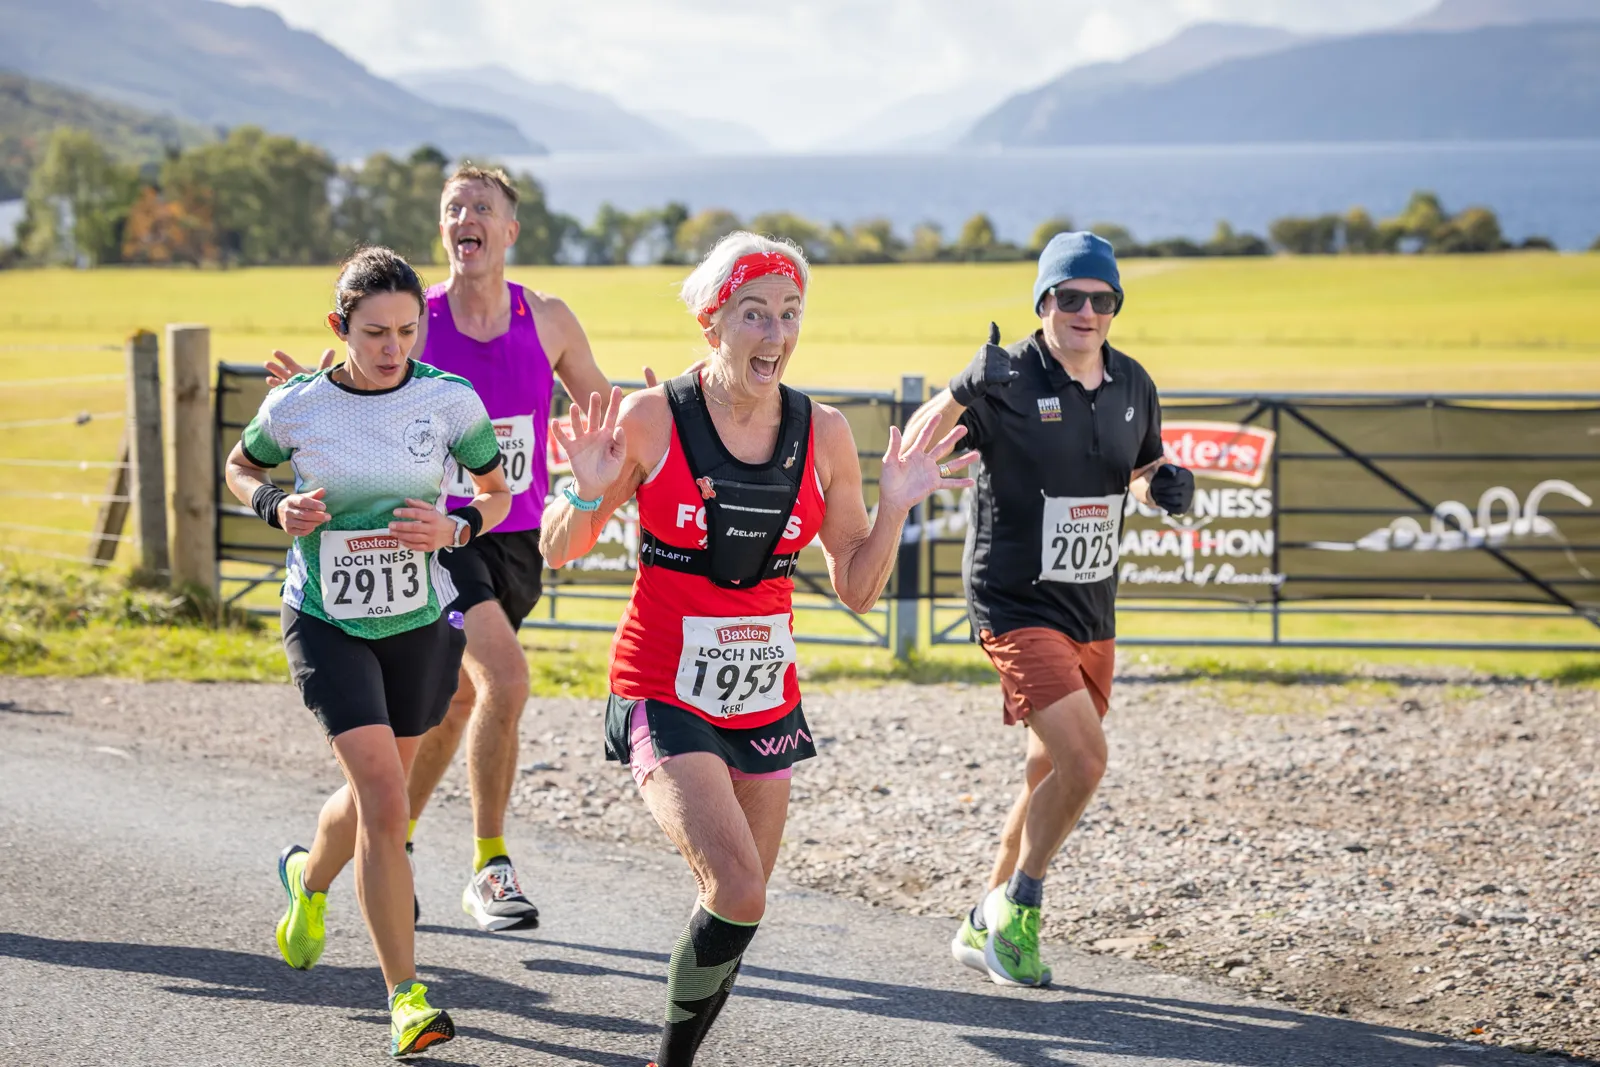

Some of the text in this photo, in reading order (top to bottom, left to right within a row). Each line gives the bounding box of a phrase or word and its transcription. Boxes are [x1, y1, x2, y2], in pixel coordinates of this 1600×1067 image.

[1163, 432, 1258, 472] xters
[1194, 488, 1273, 518] NESS
[1072, 506, 1108, 518] Baxters
[733, 529, 767, 538] ZELAFIT
[1056, 520, 1114, 534] LOCH NESS
[350, 538, 398, 551] Baxters
[1119, 528, 1275, 557] ARATHON
[334, 550, 414, 567] LOCH NESS
[1051, 533, 1113, 570] 2025
[331, 562, 419, 605] 2913
[1075, 572, 1097, 580] PETER
[367, 605, 392, 615] AGA
[720, 628, 769, 642] Baxters
[699, 646, 784, 661] LOCH NESS
[692, 660, 783, 701] 1953
